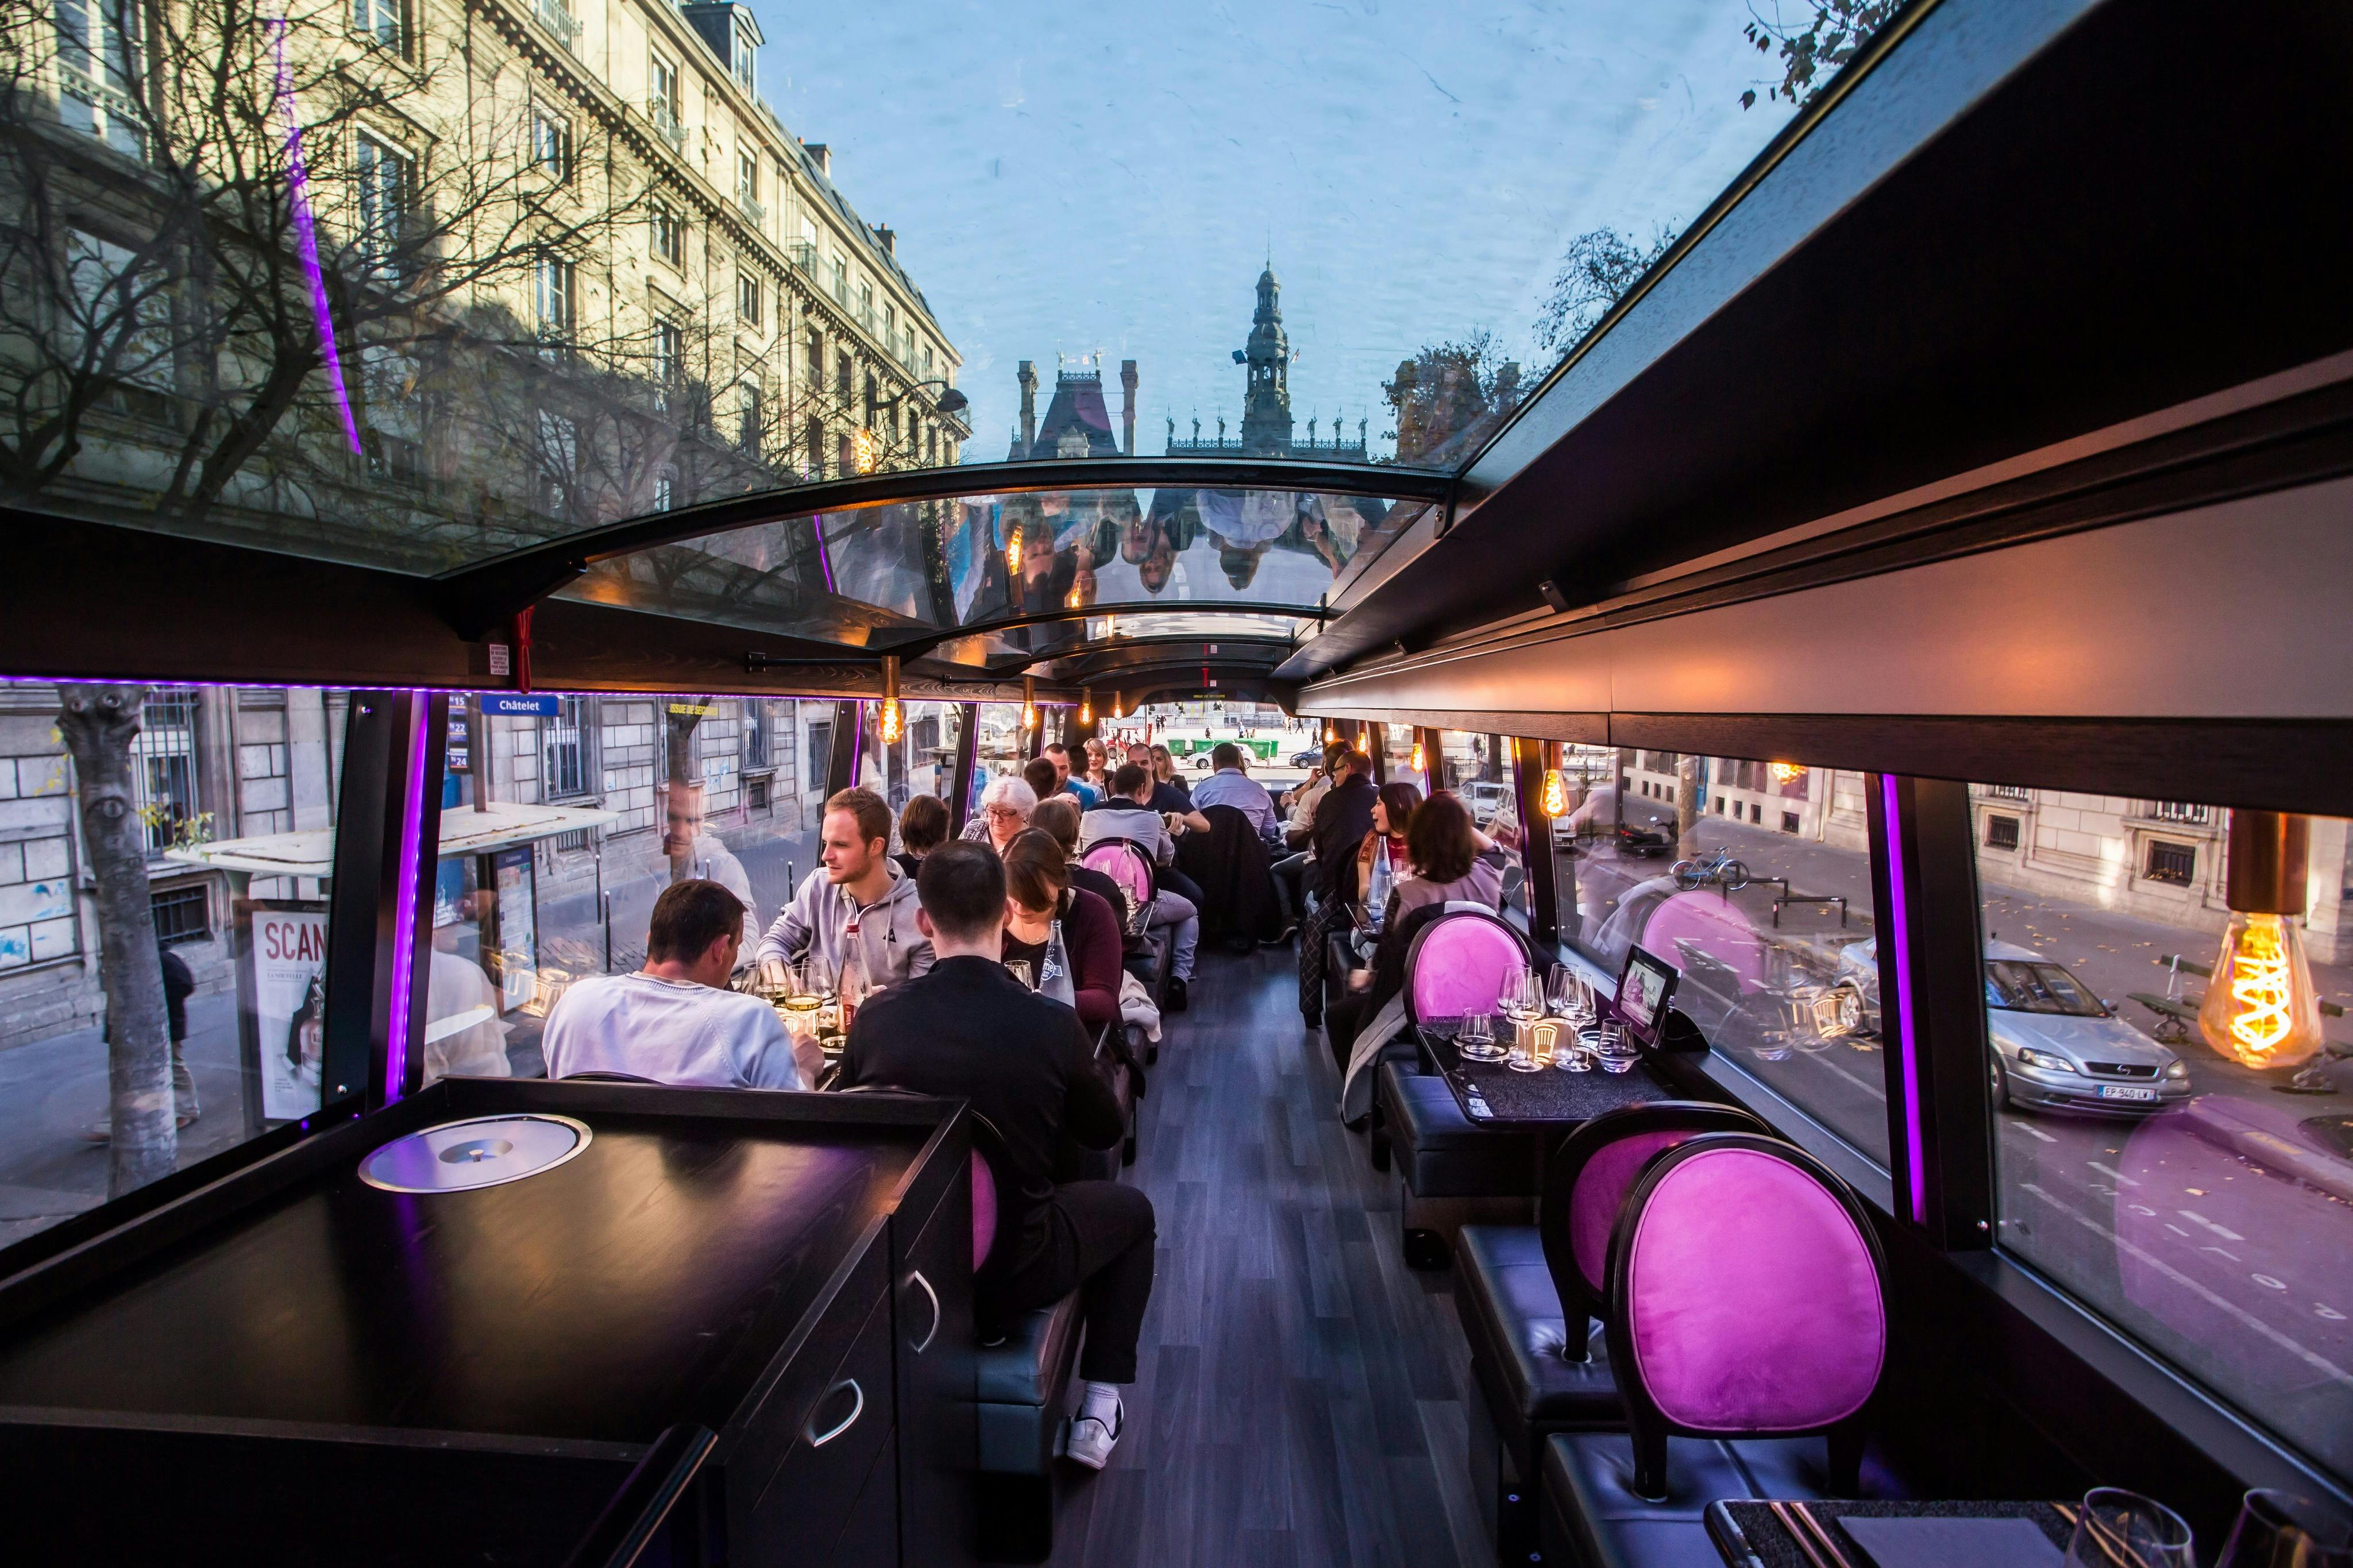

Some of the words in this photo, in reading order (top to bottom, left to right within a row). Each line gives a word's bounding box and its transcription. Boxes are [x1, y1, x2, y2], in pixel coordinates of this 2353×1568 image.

[499, 700, 539, 711] Châtelet
[670, 703, 686, 713] ISSUE
[686, 705, 694, 715] DE
[695, 705, 718, 717] SECO
